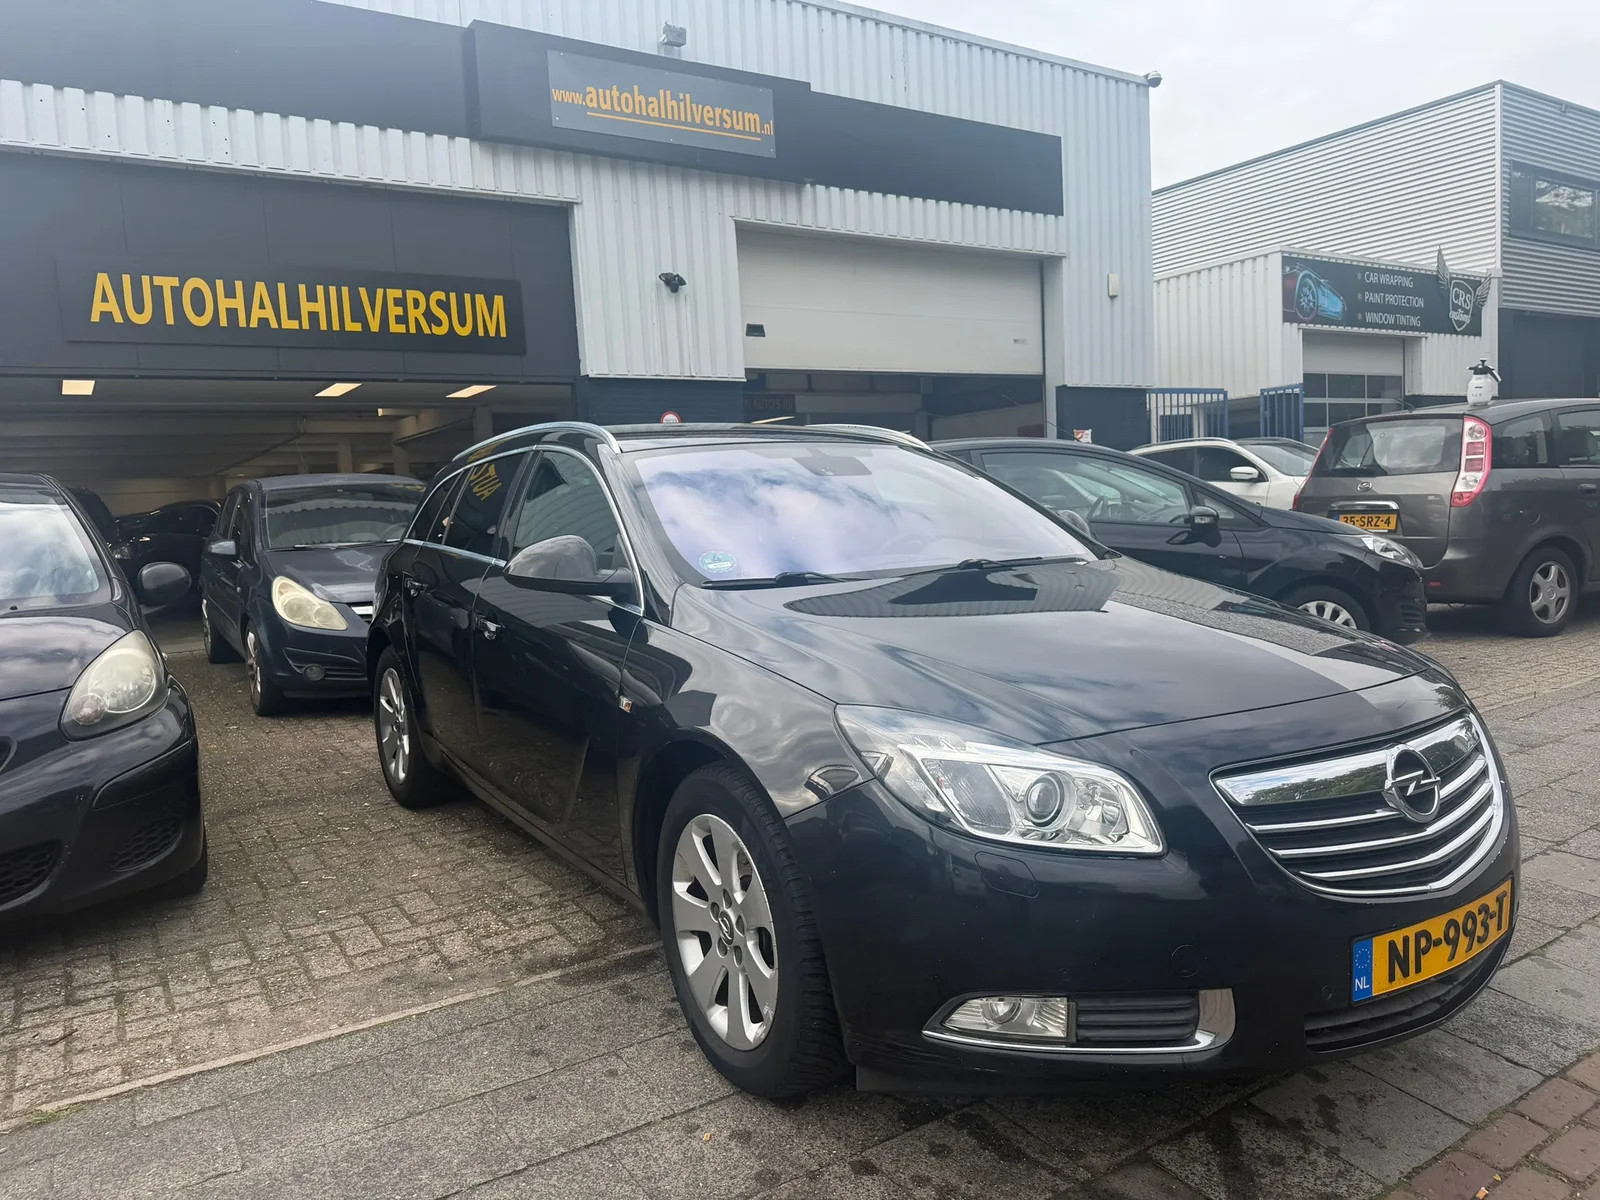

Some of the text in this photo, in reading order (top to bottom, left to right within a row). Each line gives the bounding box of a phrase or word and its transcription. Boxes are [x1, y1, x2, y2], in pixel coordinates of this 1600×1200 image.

[552, 85, 774, 136] www.autohalhilversum.nl
[1364, 271, 1414, 288] CAR WRAPPING
[90, 272, 507, 338] AUTOHALHILVERSUM
[1364, 291, 1424, 308] PAINT PROTECTION
[1452, 287, 1472, 310] CRS
[1365, 312, 1421, 327] WINDOW TINTING
[1388, 890, 1508, 984] NP-993-T
[1355, 976, 1370, 991] NL
